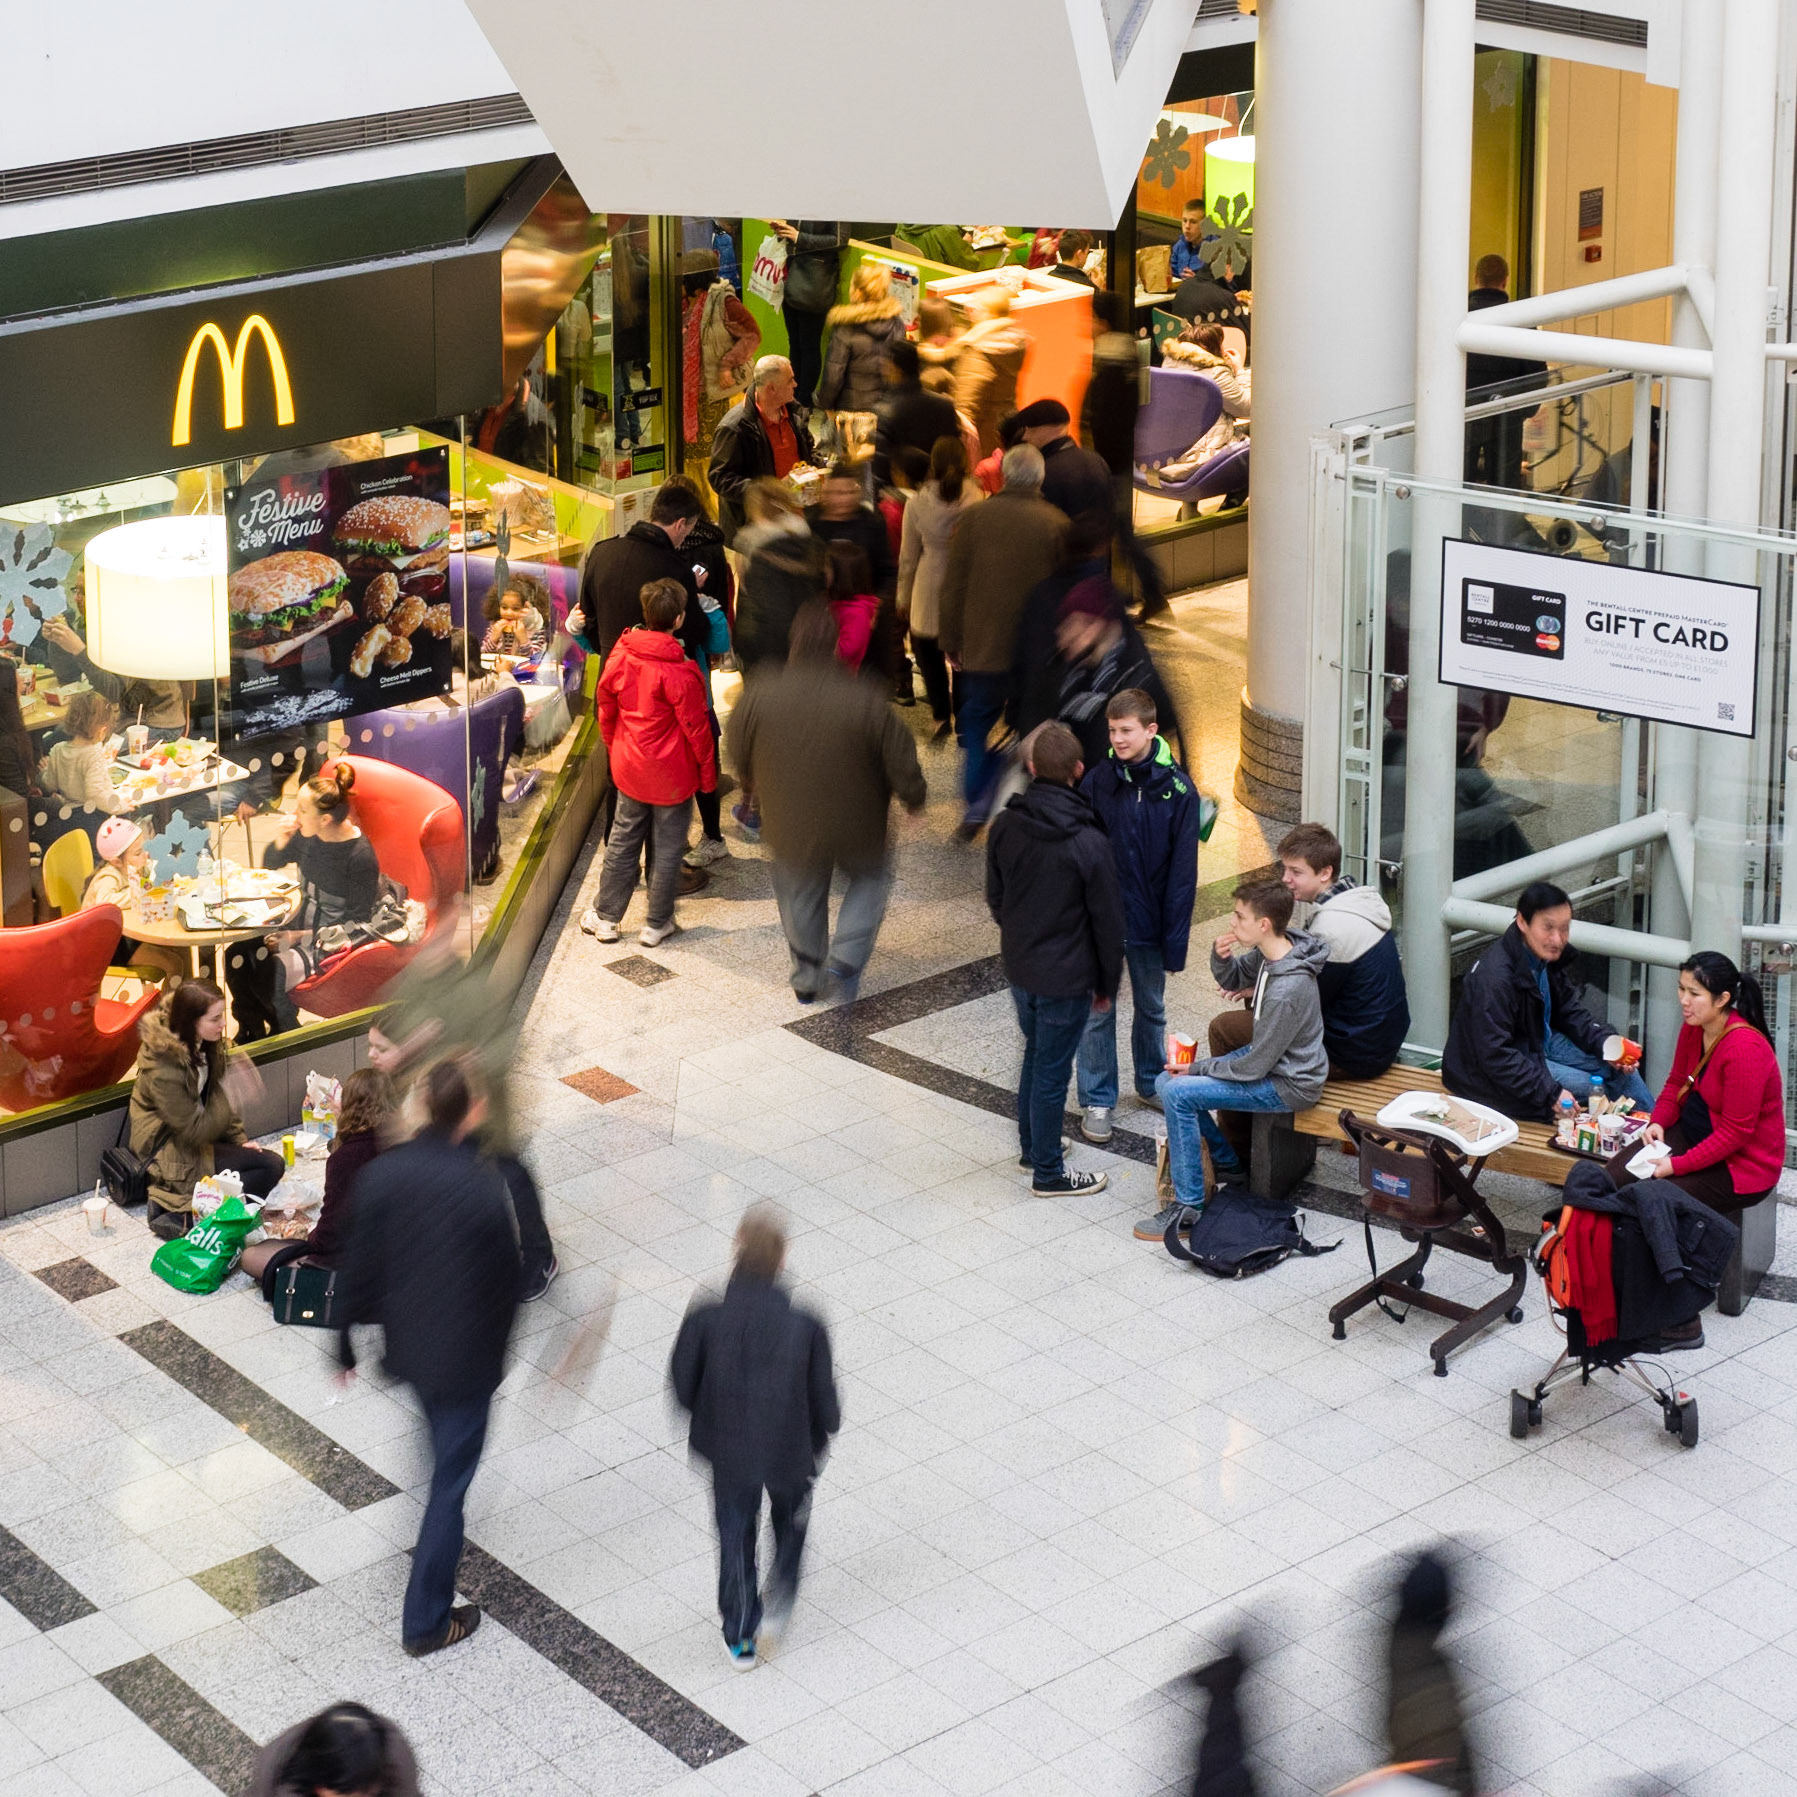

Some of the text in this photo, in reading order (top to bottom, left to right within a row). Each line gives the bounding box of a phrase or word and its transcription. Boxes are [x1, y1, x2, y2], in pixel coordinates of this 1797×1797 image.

[382, 475, 413, 485] Celebration
[238, 488, 326, 530] Festive
[267, 519, 324, 545] Menu
[1531, 594, 1562, 605] GIFT CARD
[1600, 602, 1627, 612] BENTALL
[1628, 607, 1652, 616] CENTRE
[1654, 611, 1680, 620] PREPAID
[1585, 611, 1729, 652] GIFT CARD
[1584, 637, 1600, 645] BUY
[1601, 639, 1628, 650] ONLINE
[1634, 645, 1674, 658] ACCEPTED
[1684, 653, 1697, 662] ALL
[1699, 656, 1728, 668] STORES
[1593, 648, 1609, 656] ANY
[1611, 651, 1634, 661] VALUE
[1636, 654, 1657, 664] FROM
[1681, 662, 1692, 670] TO
[241, 679, 259, 689] Festive
[380, 675, 399, 684] Cheese
